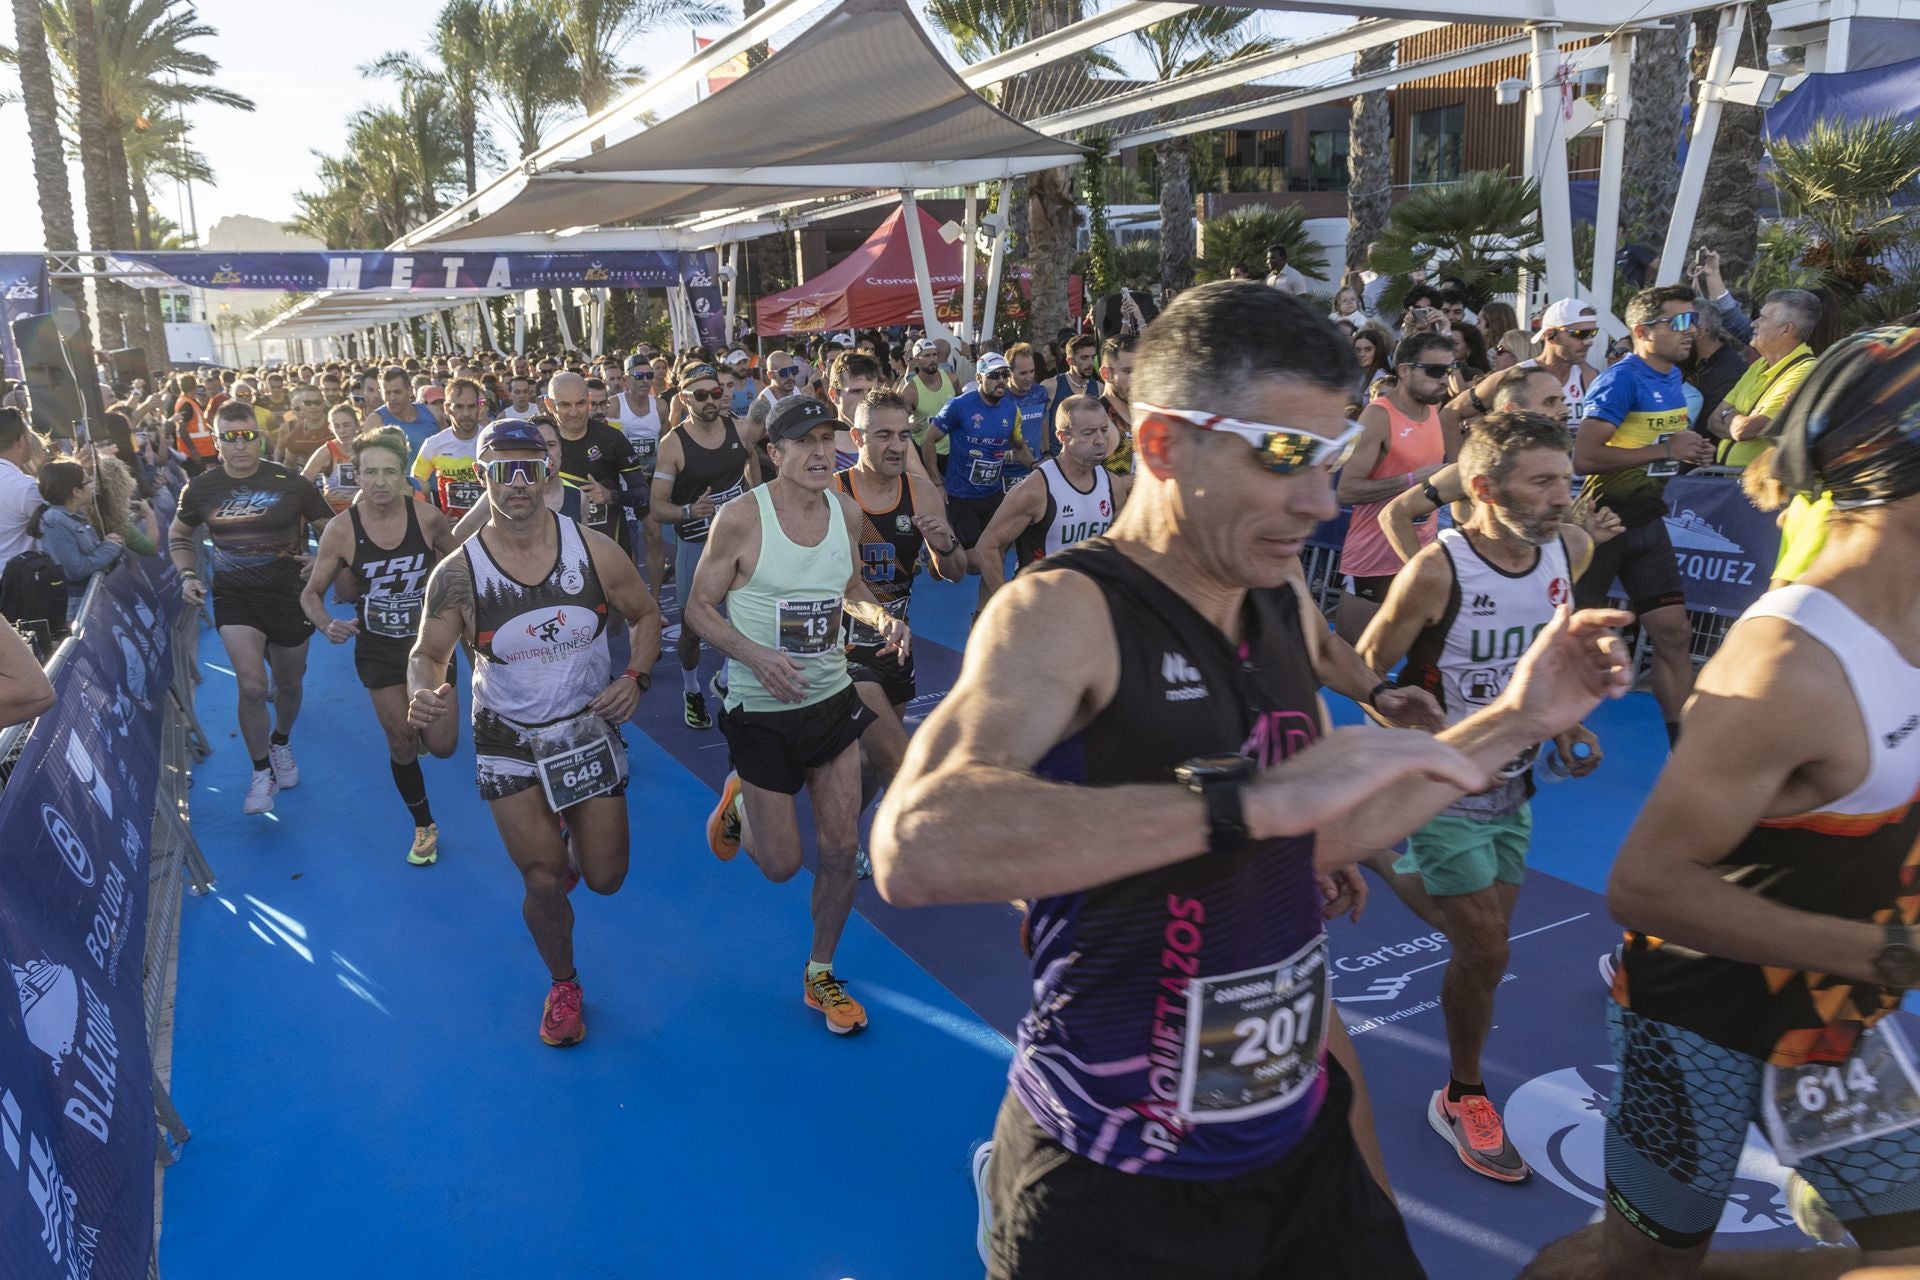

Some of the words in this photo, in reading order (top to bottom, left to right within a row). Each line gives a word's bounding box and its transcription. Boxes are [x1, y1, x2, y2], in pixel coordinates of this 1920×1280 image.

[327, 256, 512, 289] META
[455, 489, 480, 499] 473
[361, 552, 425, 579] TRI
[377, 611, 410, 625] 131
[803, 616, 828, 637] 13
[562, 760, 604, 788] 648
[52, 817, 87, 874] B
[85, 860, 127, 971] BOLUDA
[1373, 996, 1442, 1027] Portuaria
[1230, 993, 1316, 1067] 201
[1795, 1057, 1880, 1113] 614
